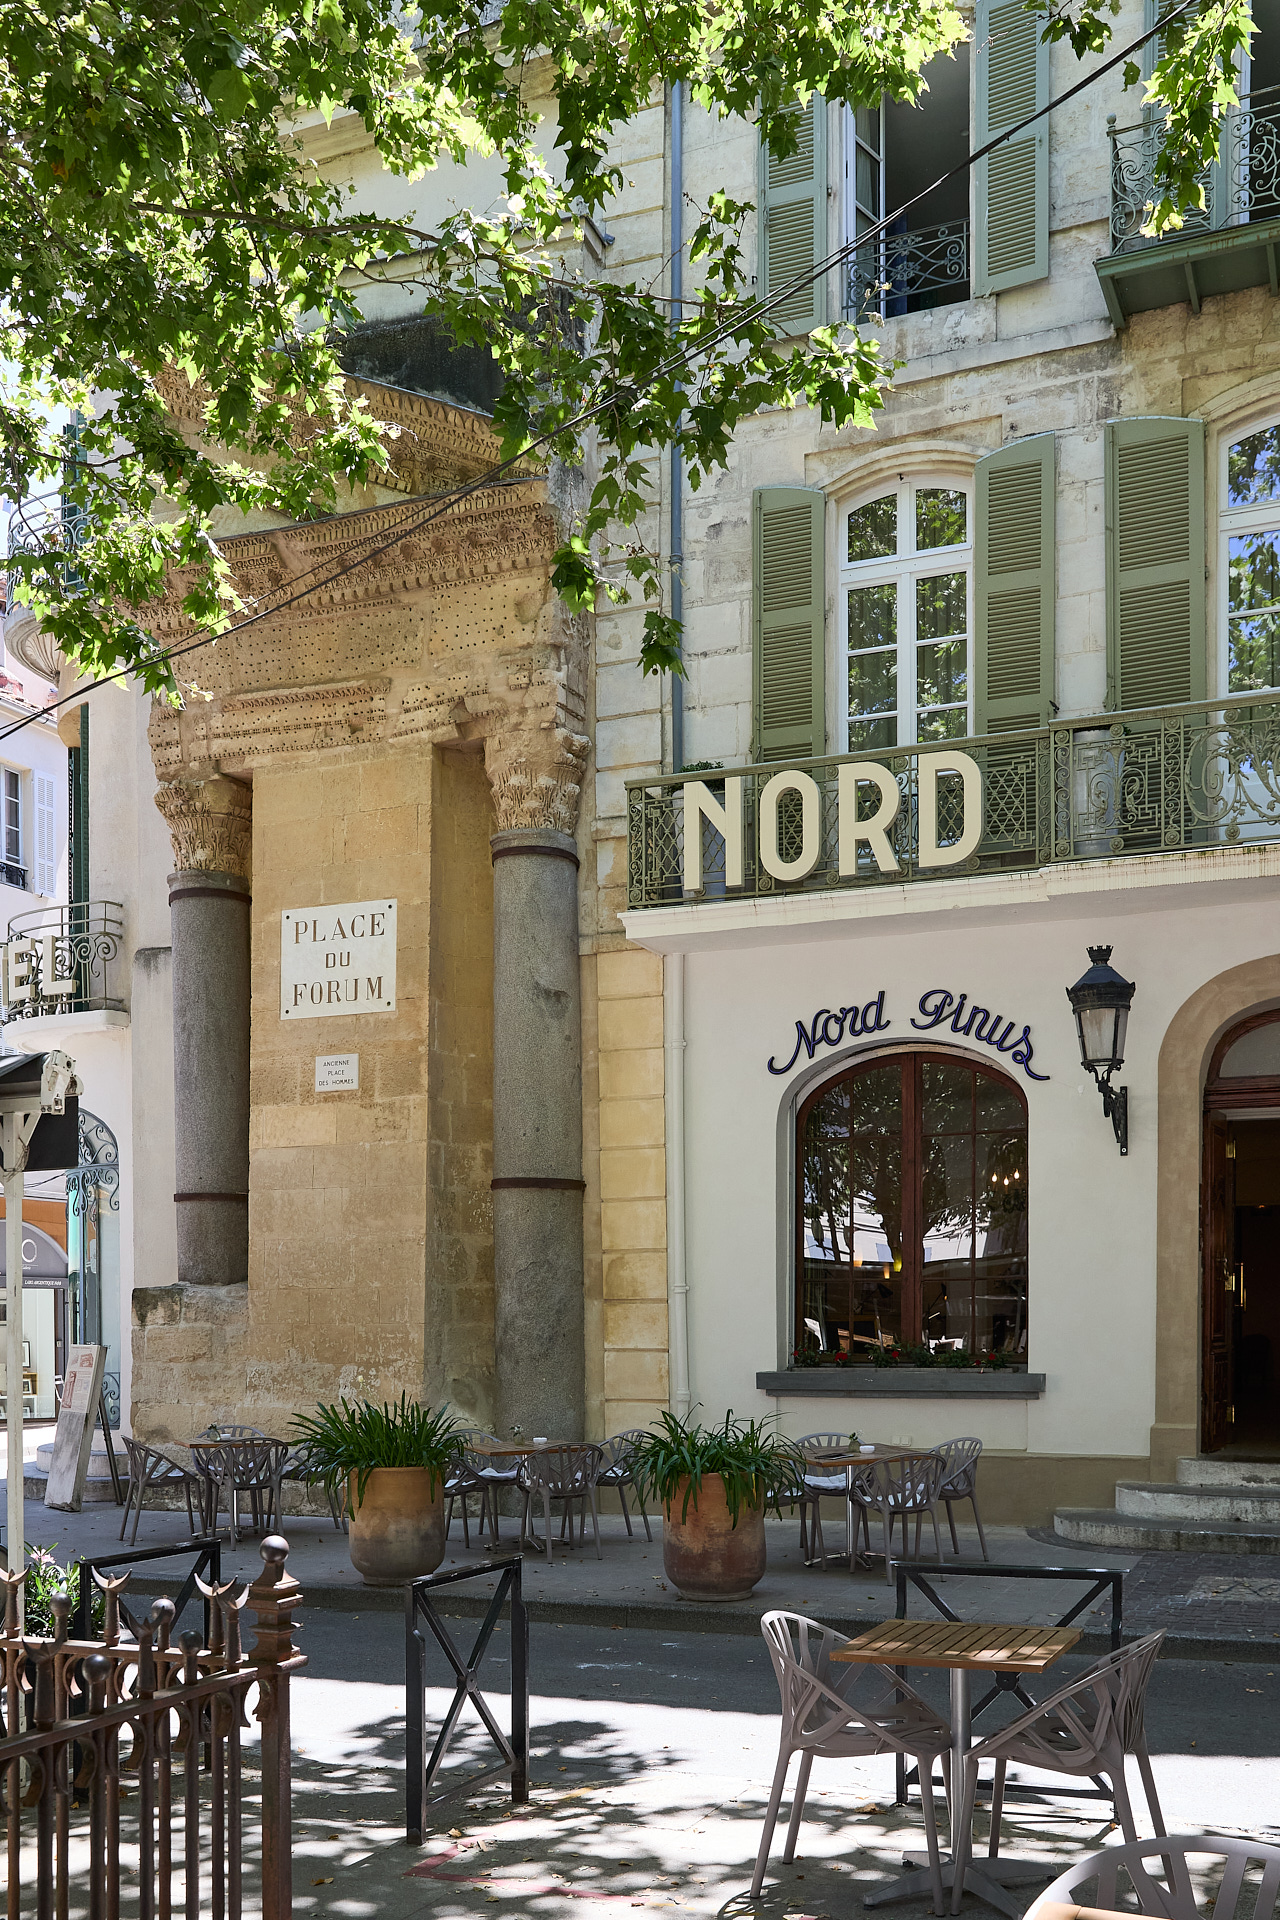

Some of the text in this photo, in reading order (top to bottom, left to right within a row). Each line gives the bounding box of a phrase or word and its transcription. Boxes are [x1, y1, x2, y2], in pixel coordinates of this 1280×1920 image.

[683, 750, 983, 891] NORD
[294, 912, 385, 944] PLACE
[325, 951, 350, 969] DU
[292, 976, 383, 1006] FORUM
[767, 989, 1051, 1080] Nord Pinus
[323, 1059, 350, 1067] ANCIENNE
[331, 1078, 354, 1086] HOMMES
